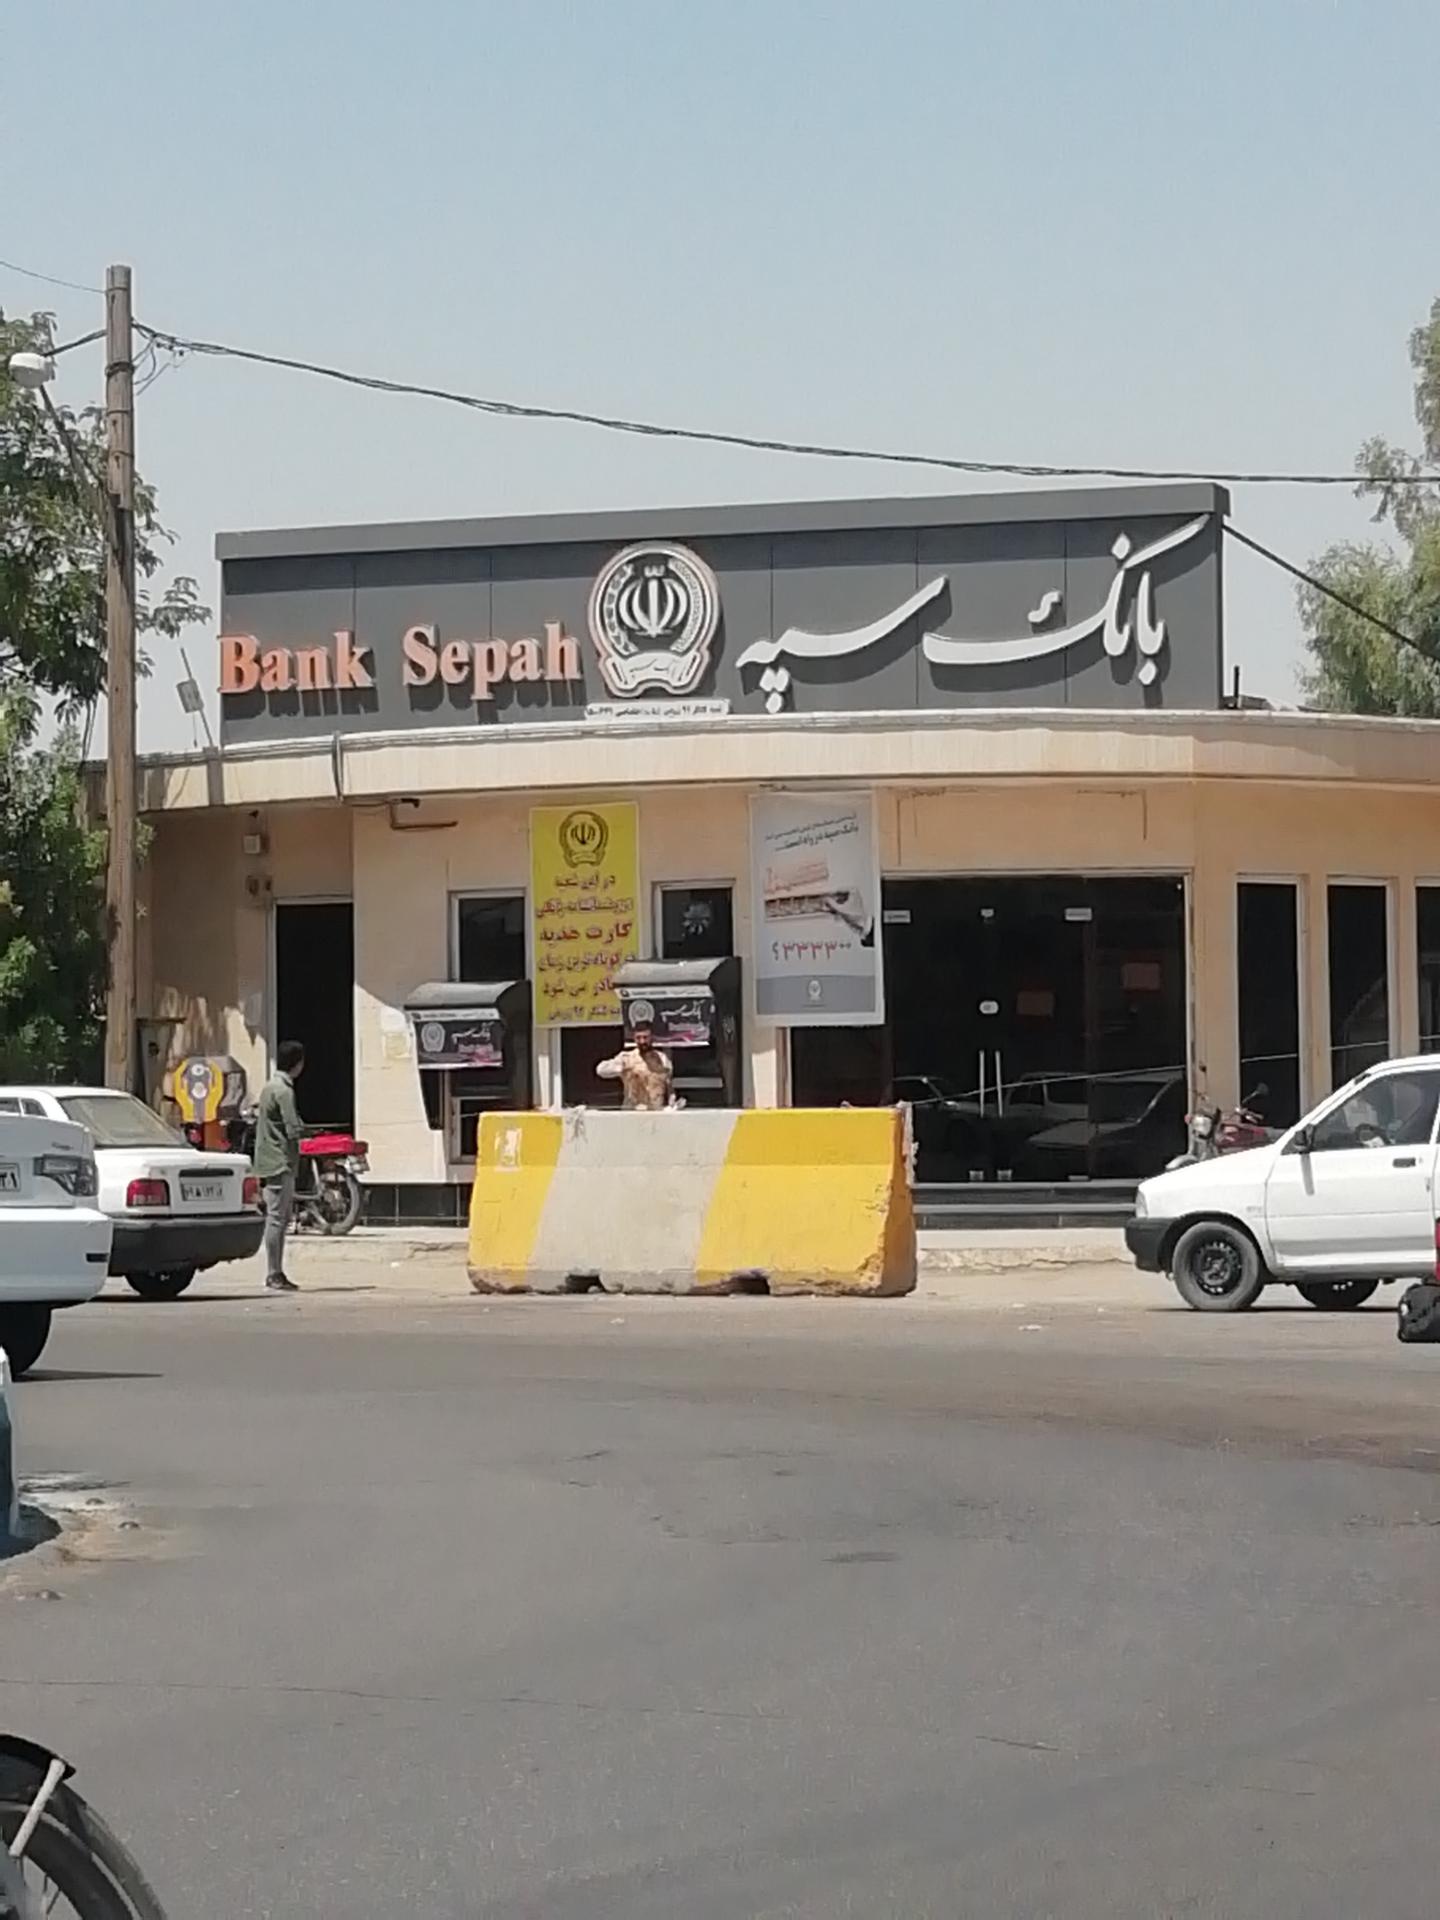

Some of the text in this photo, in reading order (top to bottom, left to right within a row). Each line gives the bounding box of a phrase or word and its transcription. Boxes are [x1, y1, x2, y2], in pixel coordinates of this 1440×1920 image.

[736, 513, 1210, 713] بانک سپه
[219, 620, 582, 701] Bank Sepah
[540, 921, 633, 946] کارت هدیه
